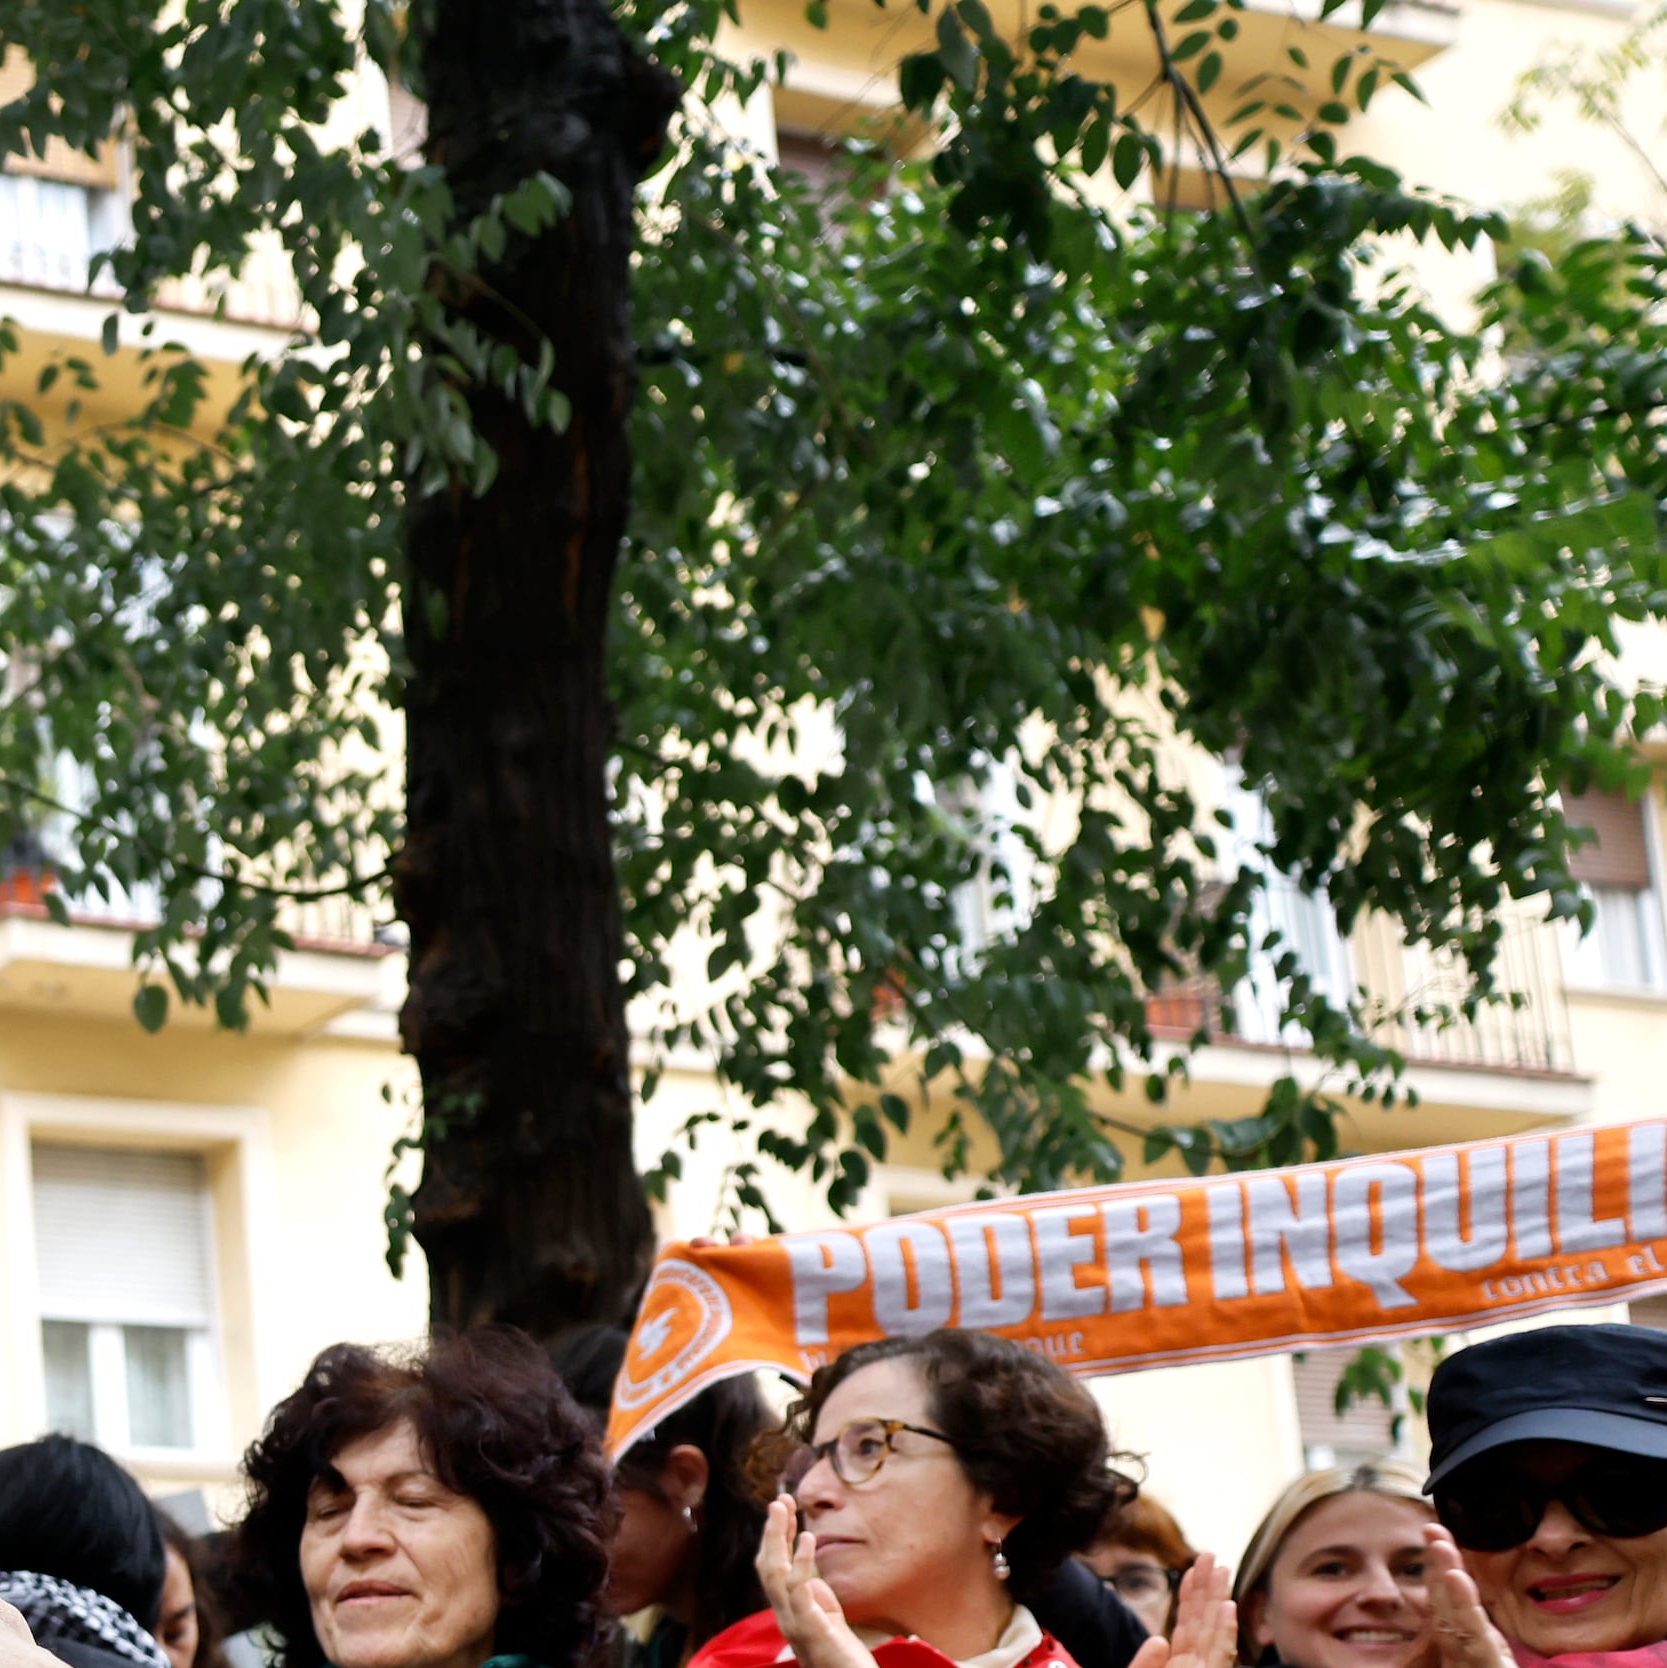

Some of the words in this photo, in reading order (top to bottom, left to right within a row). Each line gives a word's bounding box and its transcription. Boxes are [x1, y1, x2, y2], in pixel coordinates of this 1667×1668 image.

[781, 1193, 1188, 1346] PODER
[1481, 1260, 1610, 1301] contra
[1627, 1245, 1666, 1276] el
